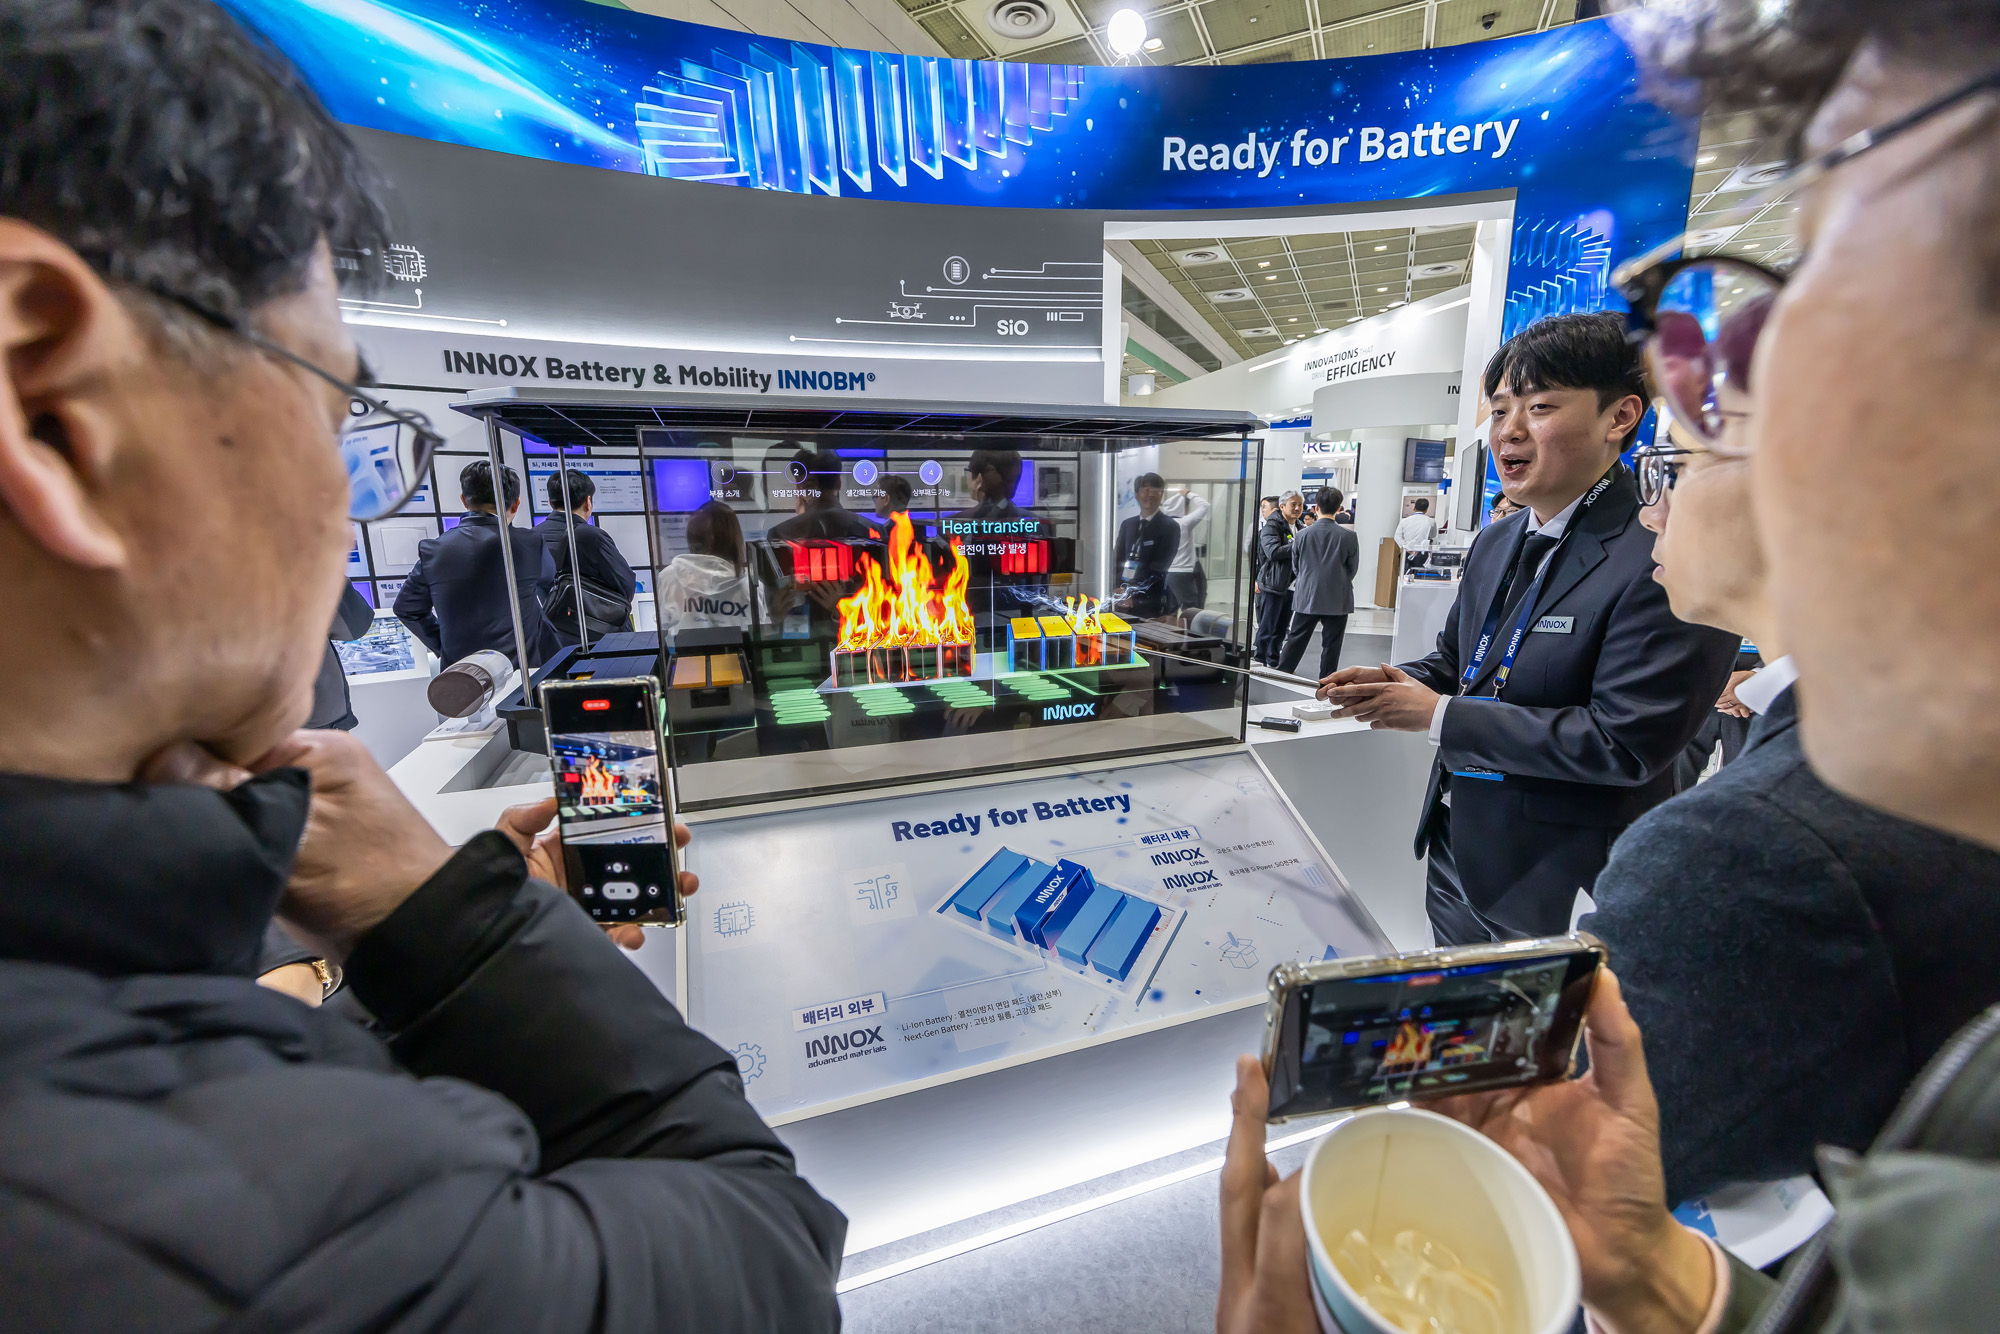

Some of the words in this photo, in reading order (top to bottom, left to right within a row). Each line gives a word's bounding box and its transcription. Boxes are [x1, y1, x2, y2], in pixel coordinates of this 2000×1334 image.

[1162, 132, 1281, 178] Ready
[1290, 128, 1349, 167] for
[1358, 118, 1520, 162] Battery
[996, 319, 1029, 336] SiO
[1304, 348, 1359, 372] INNOVATIONS
[1360, 345, 1374, 356] THAT
[1311, 370, 1326, 380] DRIVE
[1326, 351, 1396, 382] EFFICIENCY
[443, 349, 539, 378] INNOX
[545, 356, 646, 388] Battery
[653, 364, 672, 385] &
[678, 364, 772, 393] Mobility
[720, 468, 725, 476] 1
[793, 468, 799, 476] 2
[863, 468, 868, 476] 3
[709, 489, 724, 498] 부품
[725, 489, 740, 498] 소개
[807, 489, 822, 497] 기능
[873, 488, 886, 497] 기능
[912, 488, 937, 496] 상부패드
[938, 488, 951, 496] 기능
[1583, 478, 1611, 507] INNOX
[942, 519, 978, 535] Heat
[981, 518, 1040, 534] transfer
[956, 544, 985, 556] 열전이
[987, 543, 1006, 555] 현상
[1008, 542, 1027, 554] 발생
[683, 596, 749, 617] INNOX
[1537, 619, 1567, 629] INNOX
[1474, 634, 1491, 662] INNOX
[1506, 628, 1522, 658] INNOX
[1043, 702, 1096, 720] INNOX
[891, 813, 981, 842] Ready
[987, 808, 1028, 828] for
[1032, 794, 1132, 821] Battery
[1140, 832, 1171, 845] 배터리
[1171, 829, 1191, 841] 내부
[1150, 847, 1205, 867] INNOX
[1189, 859, 1210, 867] Lithium
[1035, 874, 1065, 904] INNOX
[1162, 869, 1219, 890] INNOX
[1197, 882, 1223, 892] materials
[802, 1003, 844, 1025] 배터리
[847, 999, 875, 1016] 외부
[901, 1021, 924, 1031] Li-Ion
[925, 1014, 953, 1026] Battery
[957, 1004, 994, 1018] 열전이방지
[1012, 996, 1028, 1007] 패드
[904, 1029, 940, 1042] Next-Gen
[941, 1021, 969, 1034] Battery
[974, 1015, 996, 1026] 고탄성
[1016, 1005, 1037, 1016] 고강성
[1037, 1002, 1053, 1011] 패드
[805, 1025, 885, 1059] INNOX
[807, 1053, 849, 1068] advanced
[849, 1045, 887, 1059] materials
